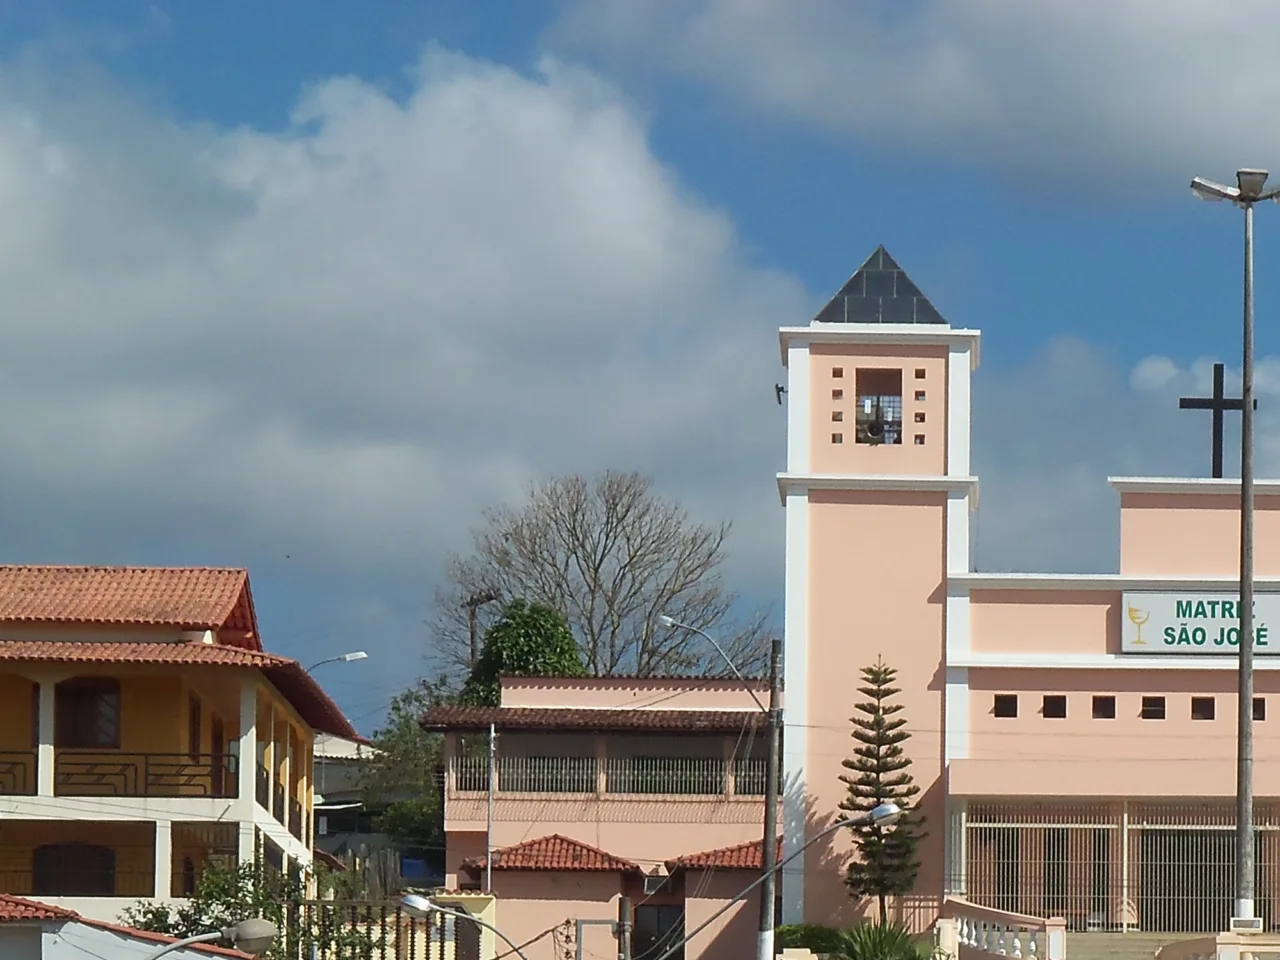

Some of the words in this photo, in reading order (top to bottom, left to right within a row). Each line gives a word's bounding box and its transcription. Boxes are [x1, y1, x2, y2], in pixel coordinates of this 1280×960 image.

[1176, 600, 1256, 619] MATRI
[1163, 622, 1207, 645] SÃO
[1213, 622, 1268, 646] JOÉ
